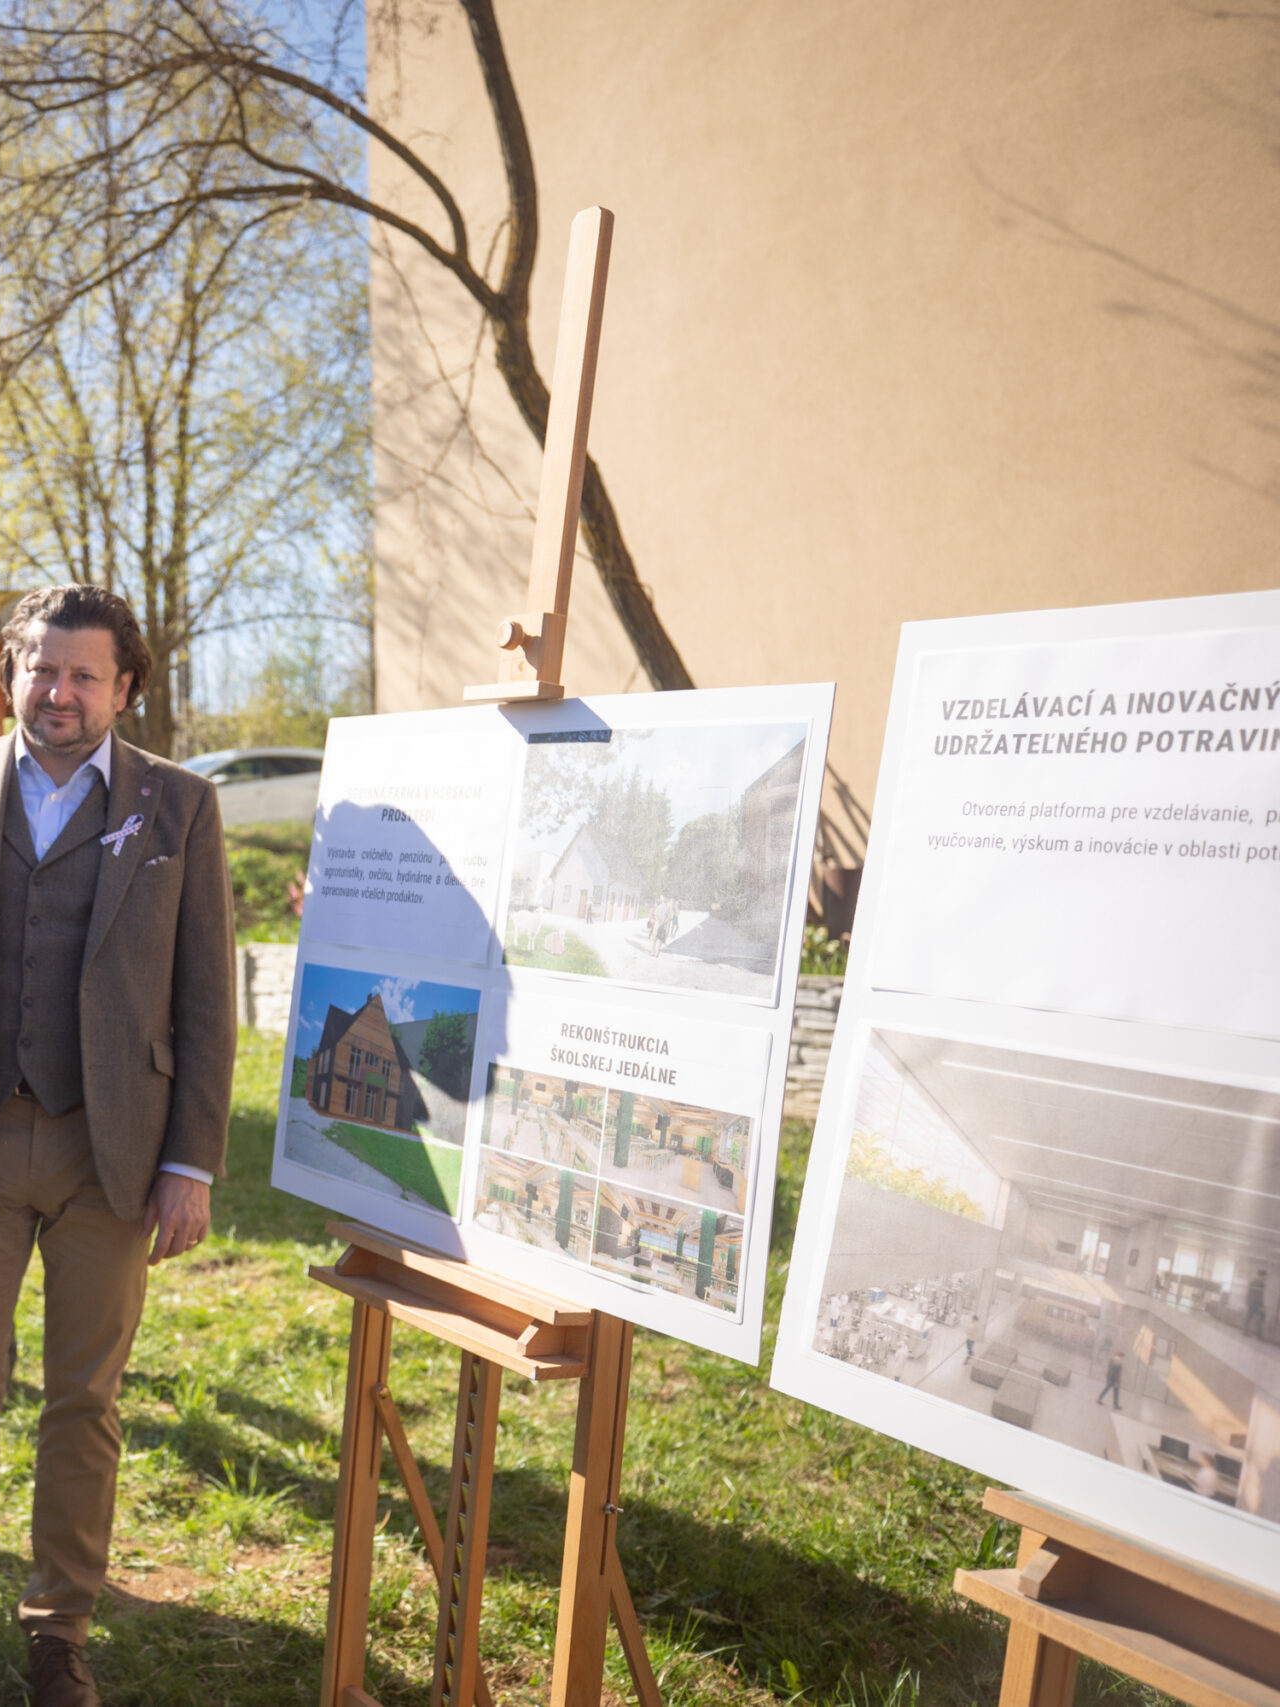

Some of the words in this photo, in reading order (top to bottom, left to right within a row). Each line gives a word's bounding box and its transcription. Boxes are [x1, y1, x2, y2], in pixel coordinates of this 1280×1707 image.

[941, 689, 1096, 721] VZDELÁVACÍ
[1099, 693, 1118, 717] A
[1126, 680, 1280, 716] INOVAČNÝ
[933, 726, 1128, 756] UDRŽATEĽNÉHO
[961, 801, 1025, 818] Otvorená
[1029, 801, 1106, 821] platforma
[1110, 807, 1138, 823] pre
[1143, 803, 1254, 825] vzdelávanie,
[927, 832, 1007, 851] vyučovanie,
[1011, 833, 1069, 854] výskum
[1073, 839, 1083, 852] a
[1088, 836, 1158, 856] inovácie
[1163, 844, 1174, 856] v
[1178, 838, 1241, 859] oblasti
[1246, 845, 1280, 864] pot
[435, 874, 442, 885] a
[560, 1022, 670, 1056] REKONŠTRUKCIA
[550, 1044, 613, 1073] ŠKOLSKEJ
[616, 1060, 678, 1086] JEDÁLNE
